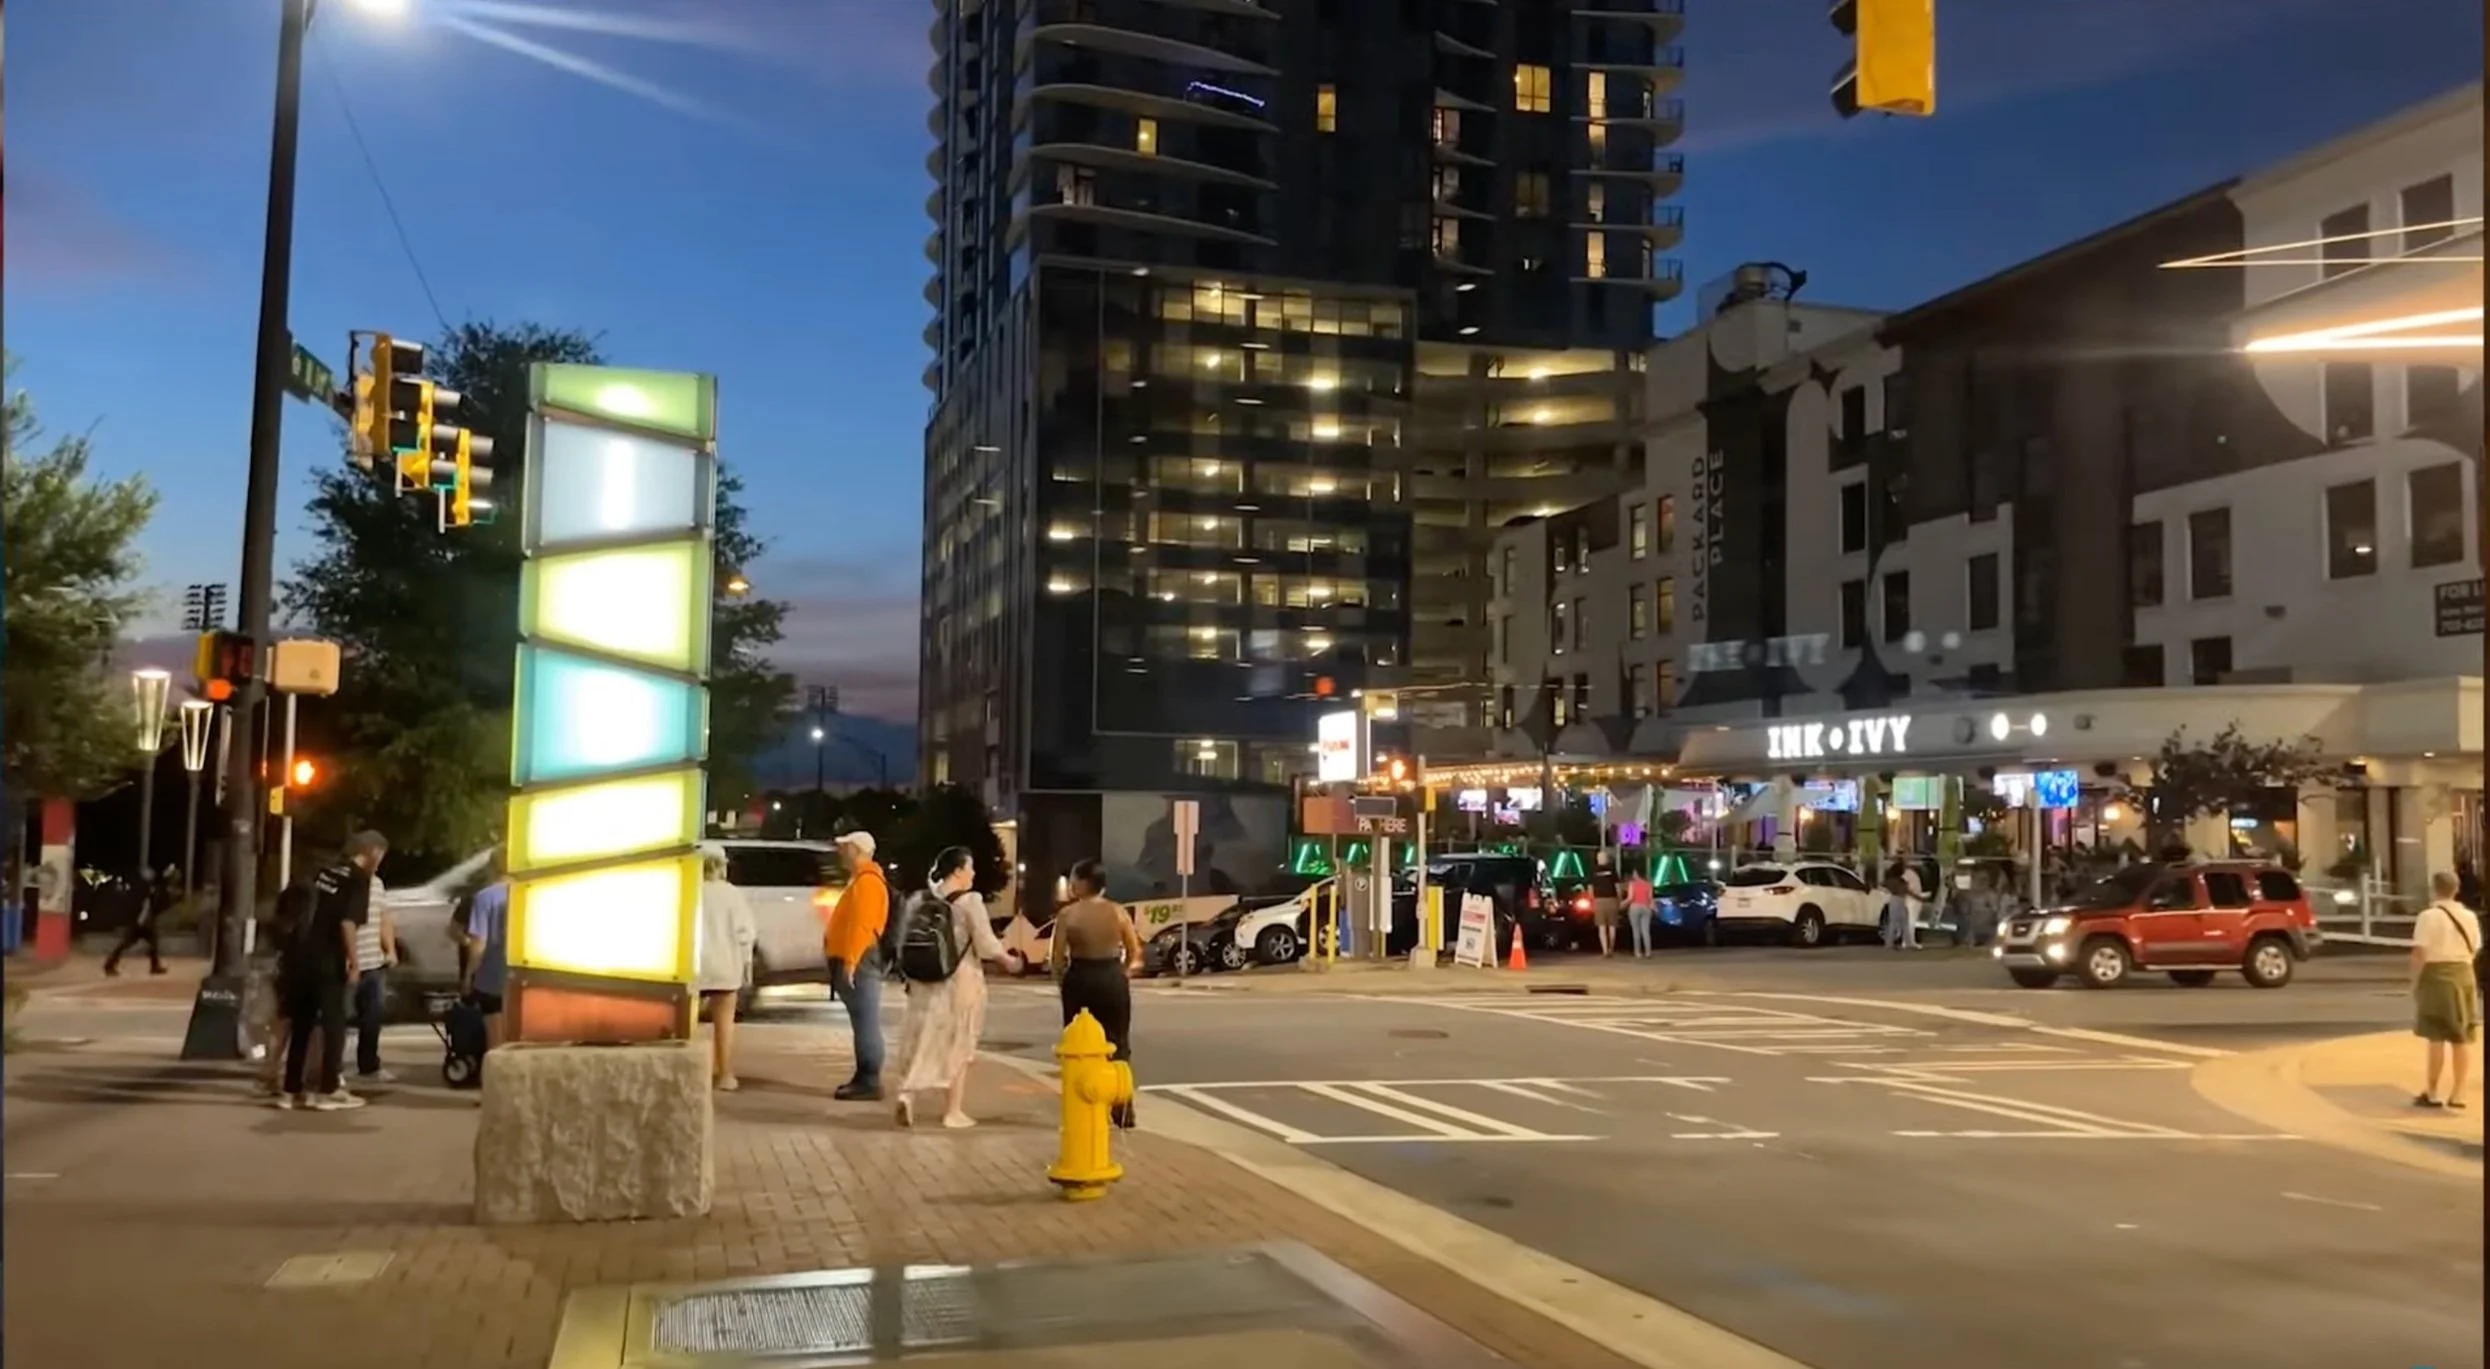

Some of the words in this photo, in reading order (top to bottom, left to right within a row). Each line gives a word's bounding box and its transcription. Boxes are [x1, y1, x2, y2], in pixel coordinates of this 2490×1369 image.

[1691, 456, 1705, 622] PACKARD
[1709, 449, 1724, 565] PLACE
[1767, 722, 1824, 758] INK
[1848, 715, 1911, 754] IVY
[1358, 817, 1374, 832] PA
